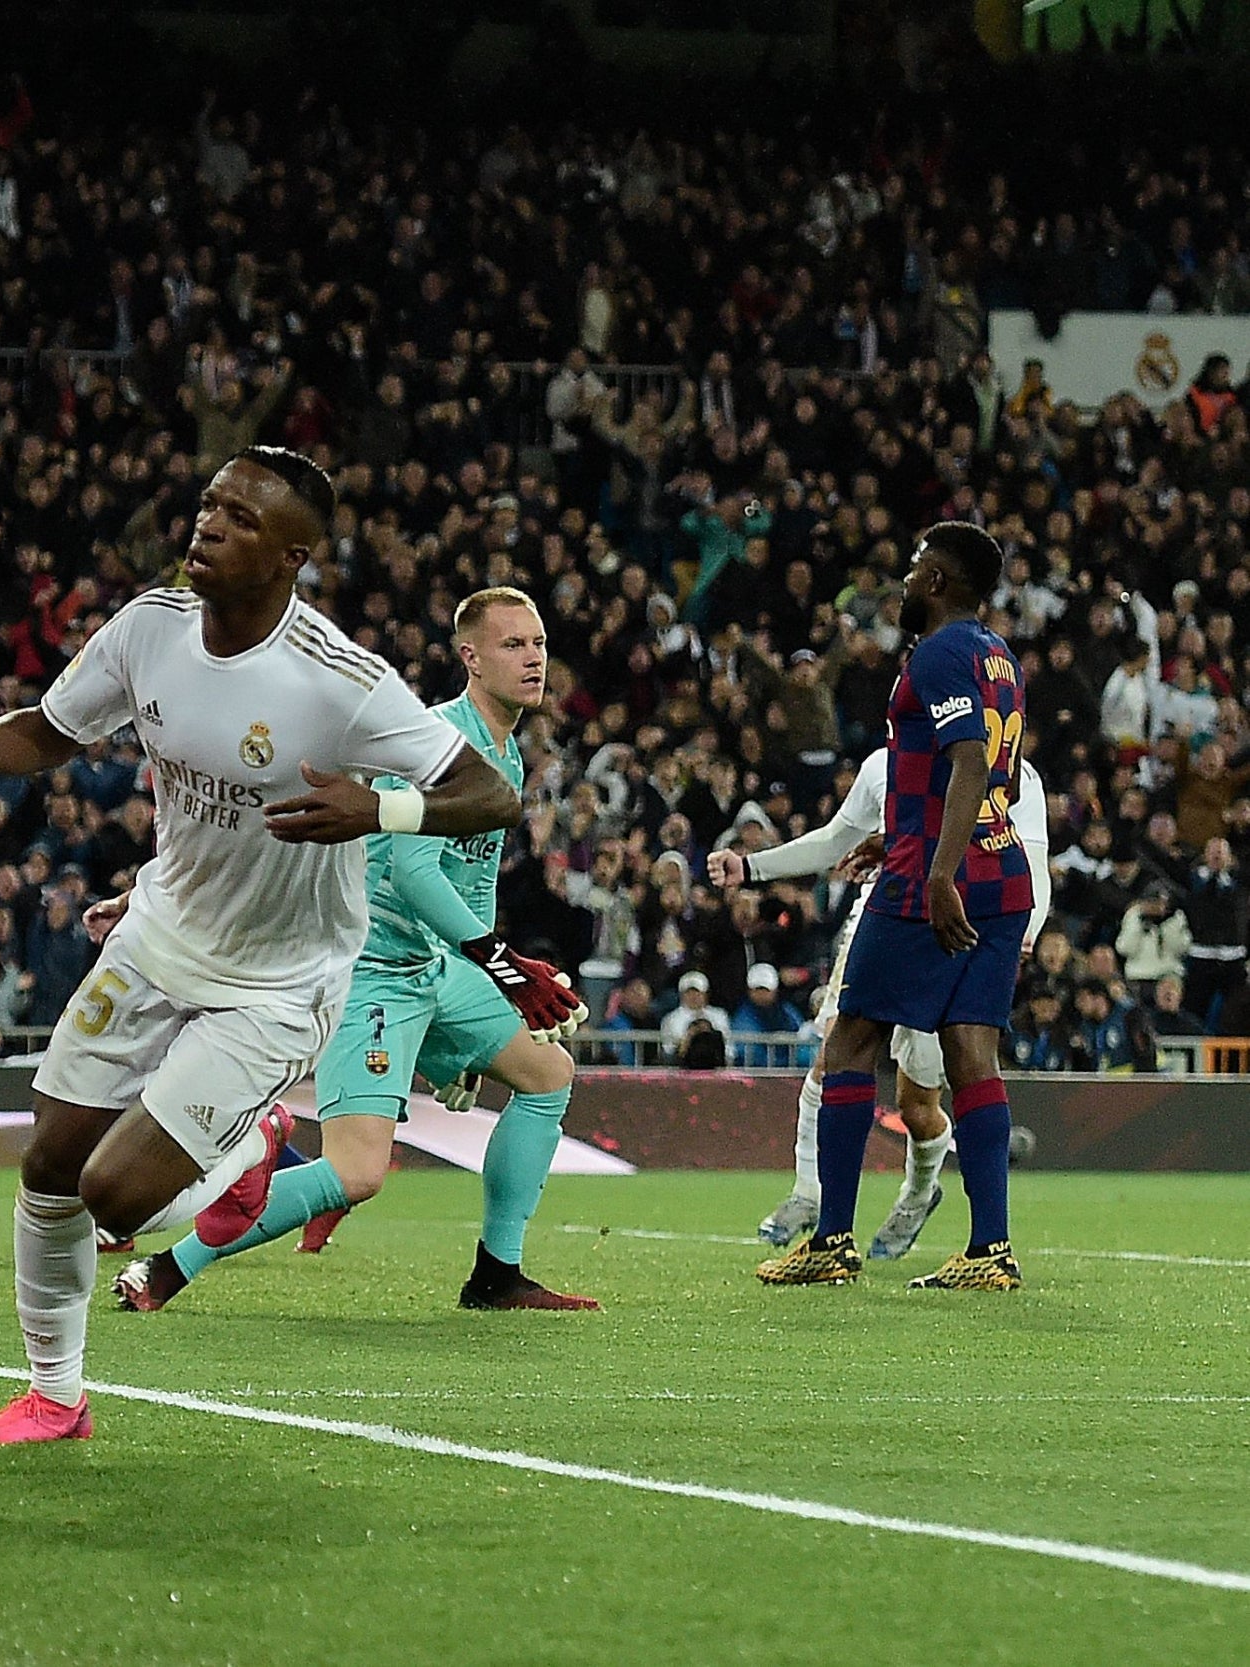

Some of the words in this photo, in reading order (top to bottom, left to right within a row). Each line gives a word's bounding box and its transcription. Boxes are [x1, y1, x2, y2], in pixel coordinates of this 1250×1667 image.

[930, 696, 972, 719] beko
[183, 793, 240, 831] BETTER
[63, 968, 130, 1037] 5
[183, 1104, 212, 1134] adidas
